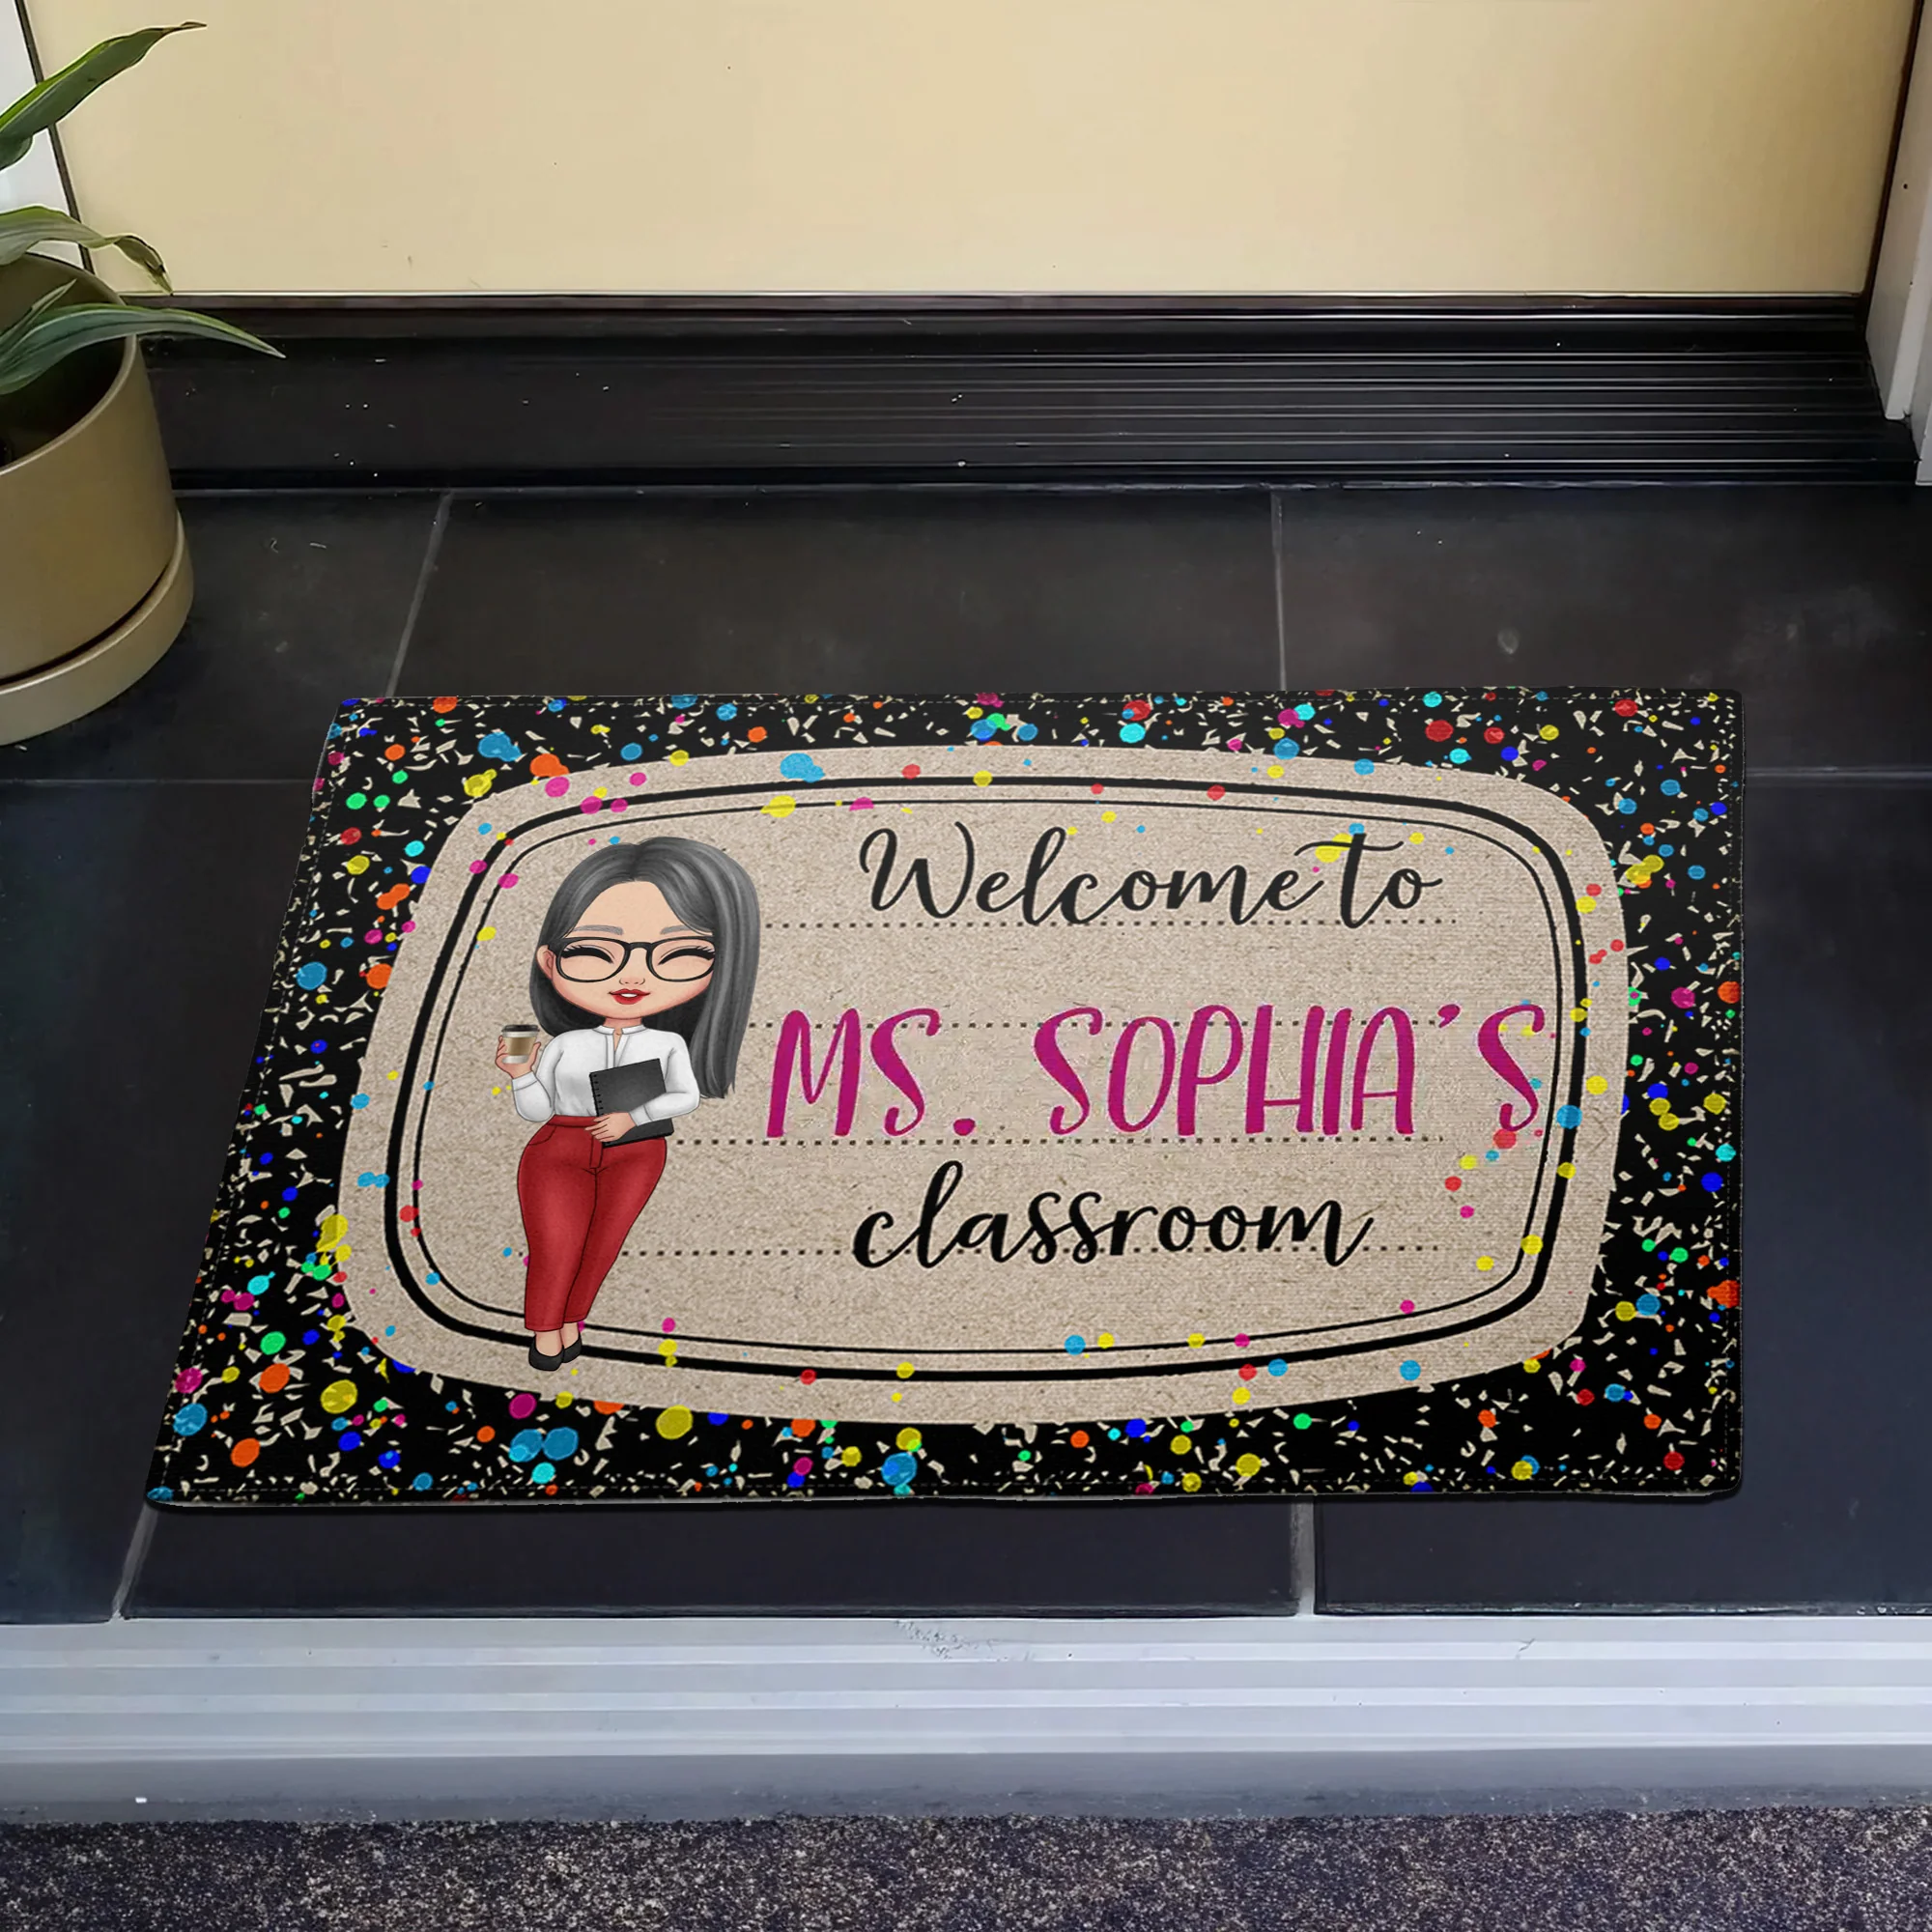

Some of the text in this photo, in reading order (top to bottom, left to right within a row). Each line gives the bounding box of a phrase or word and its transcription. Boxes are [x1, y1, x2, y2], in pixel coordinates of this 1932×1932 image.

[860, 821, 1443, 929] Welcome to
[766, 1003, 1546, 1139] MS. SOPHIA'S
[852, 1159, 1375, 1268] classroom
